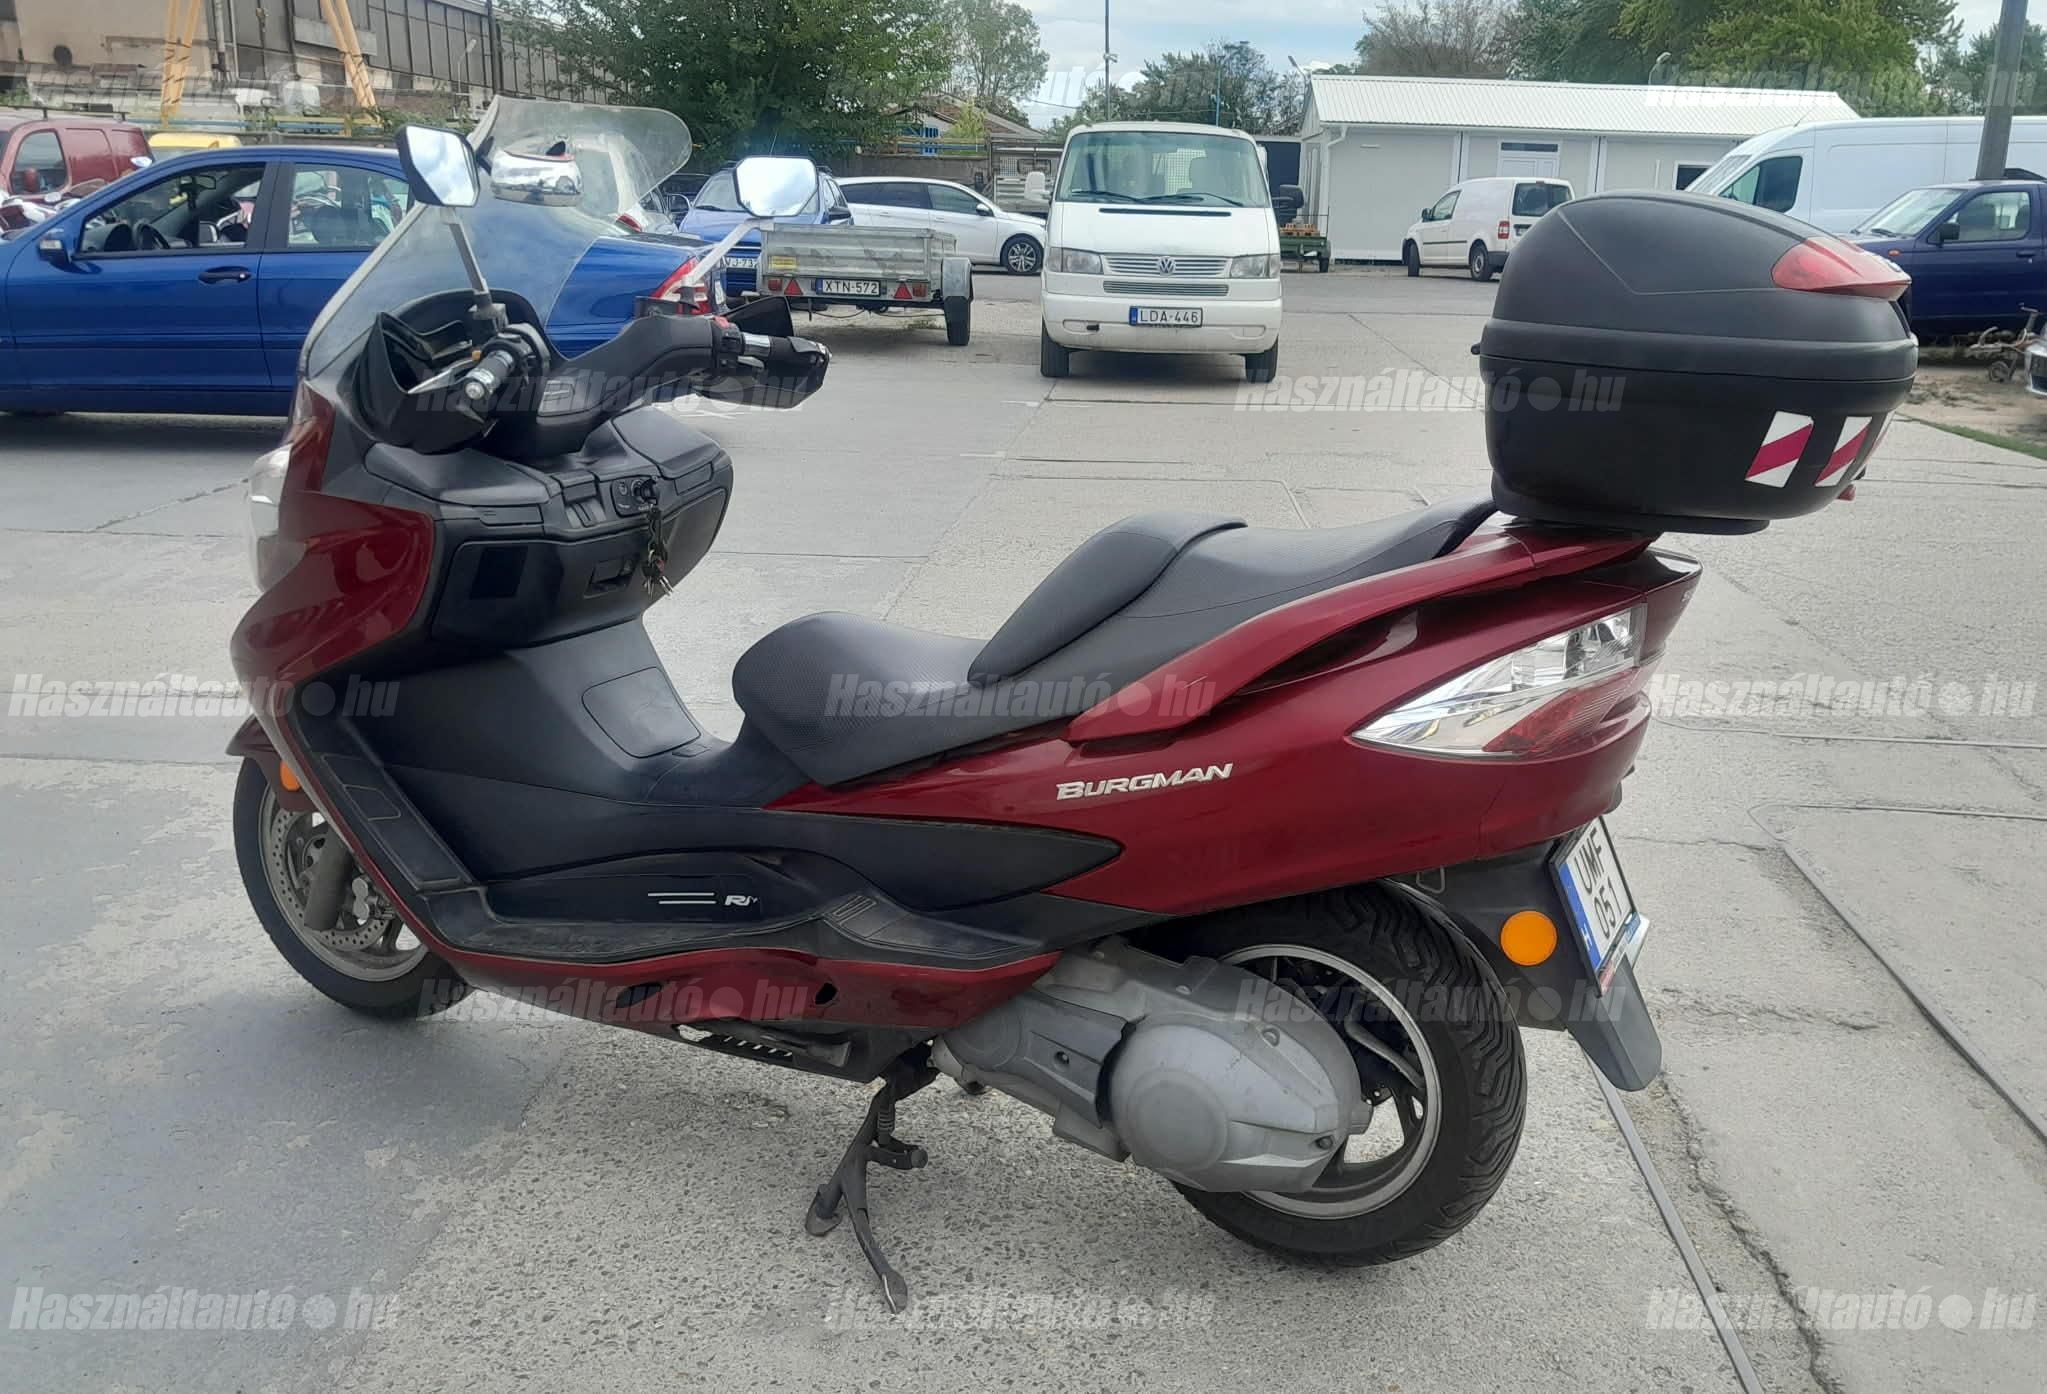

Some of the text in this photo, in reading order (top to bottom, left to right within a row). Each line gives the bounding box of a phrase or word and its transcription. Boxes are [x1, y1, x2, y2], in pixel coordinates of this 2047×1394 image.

[824, 281, 879, 294] XTN-572
[1140, 310, 1198, 323] LDA-446
[1056, 763, 1234, 800] BURGMAN
[1574, 827, 1605, 896] UMF
[1593, 876, 1622, 941] 051
